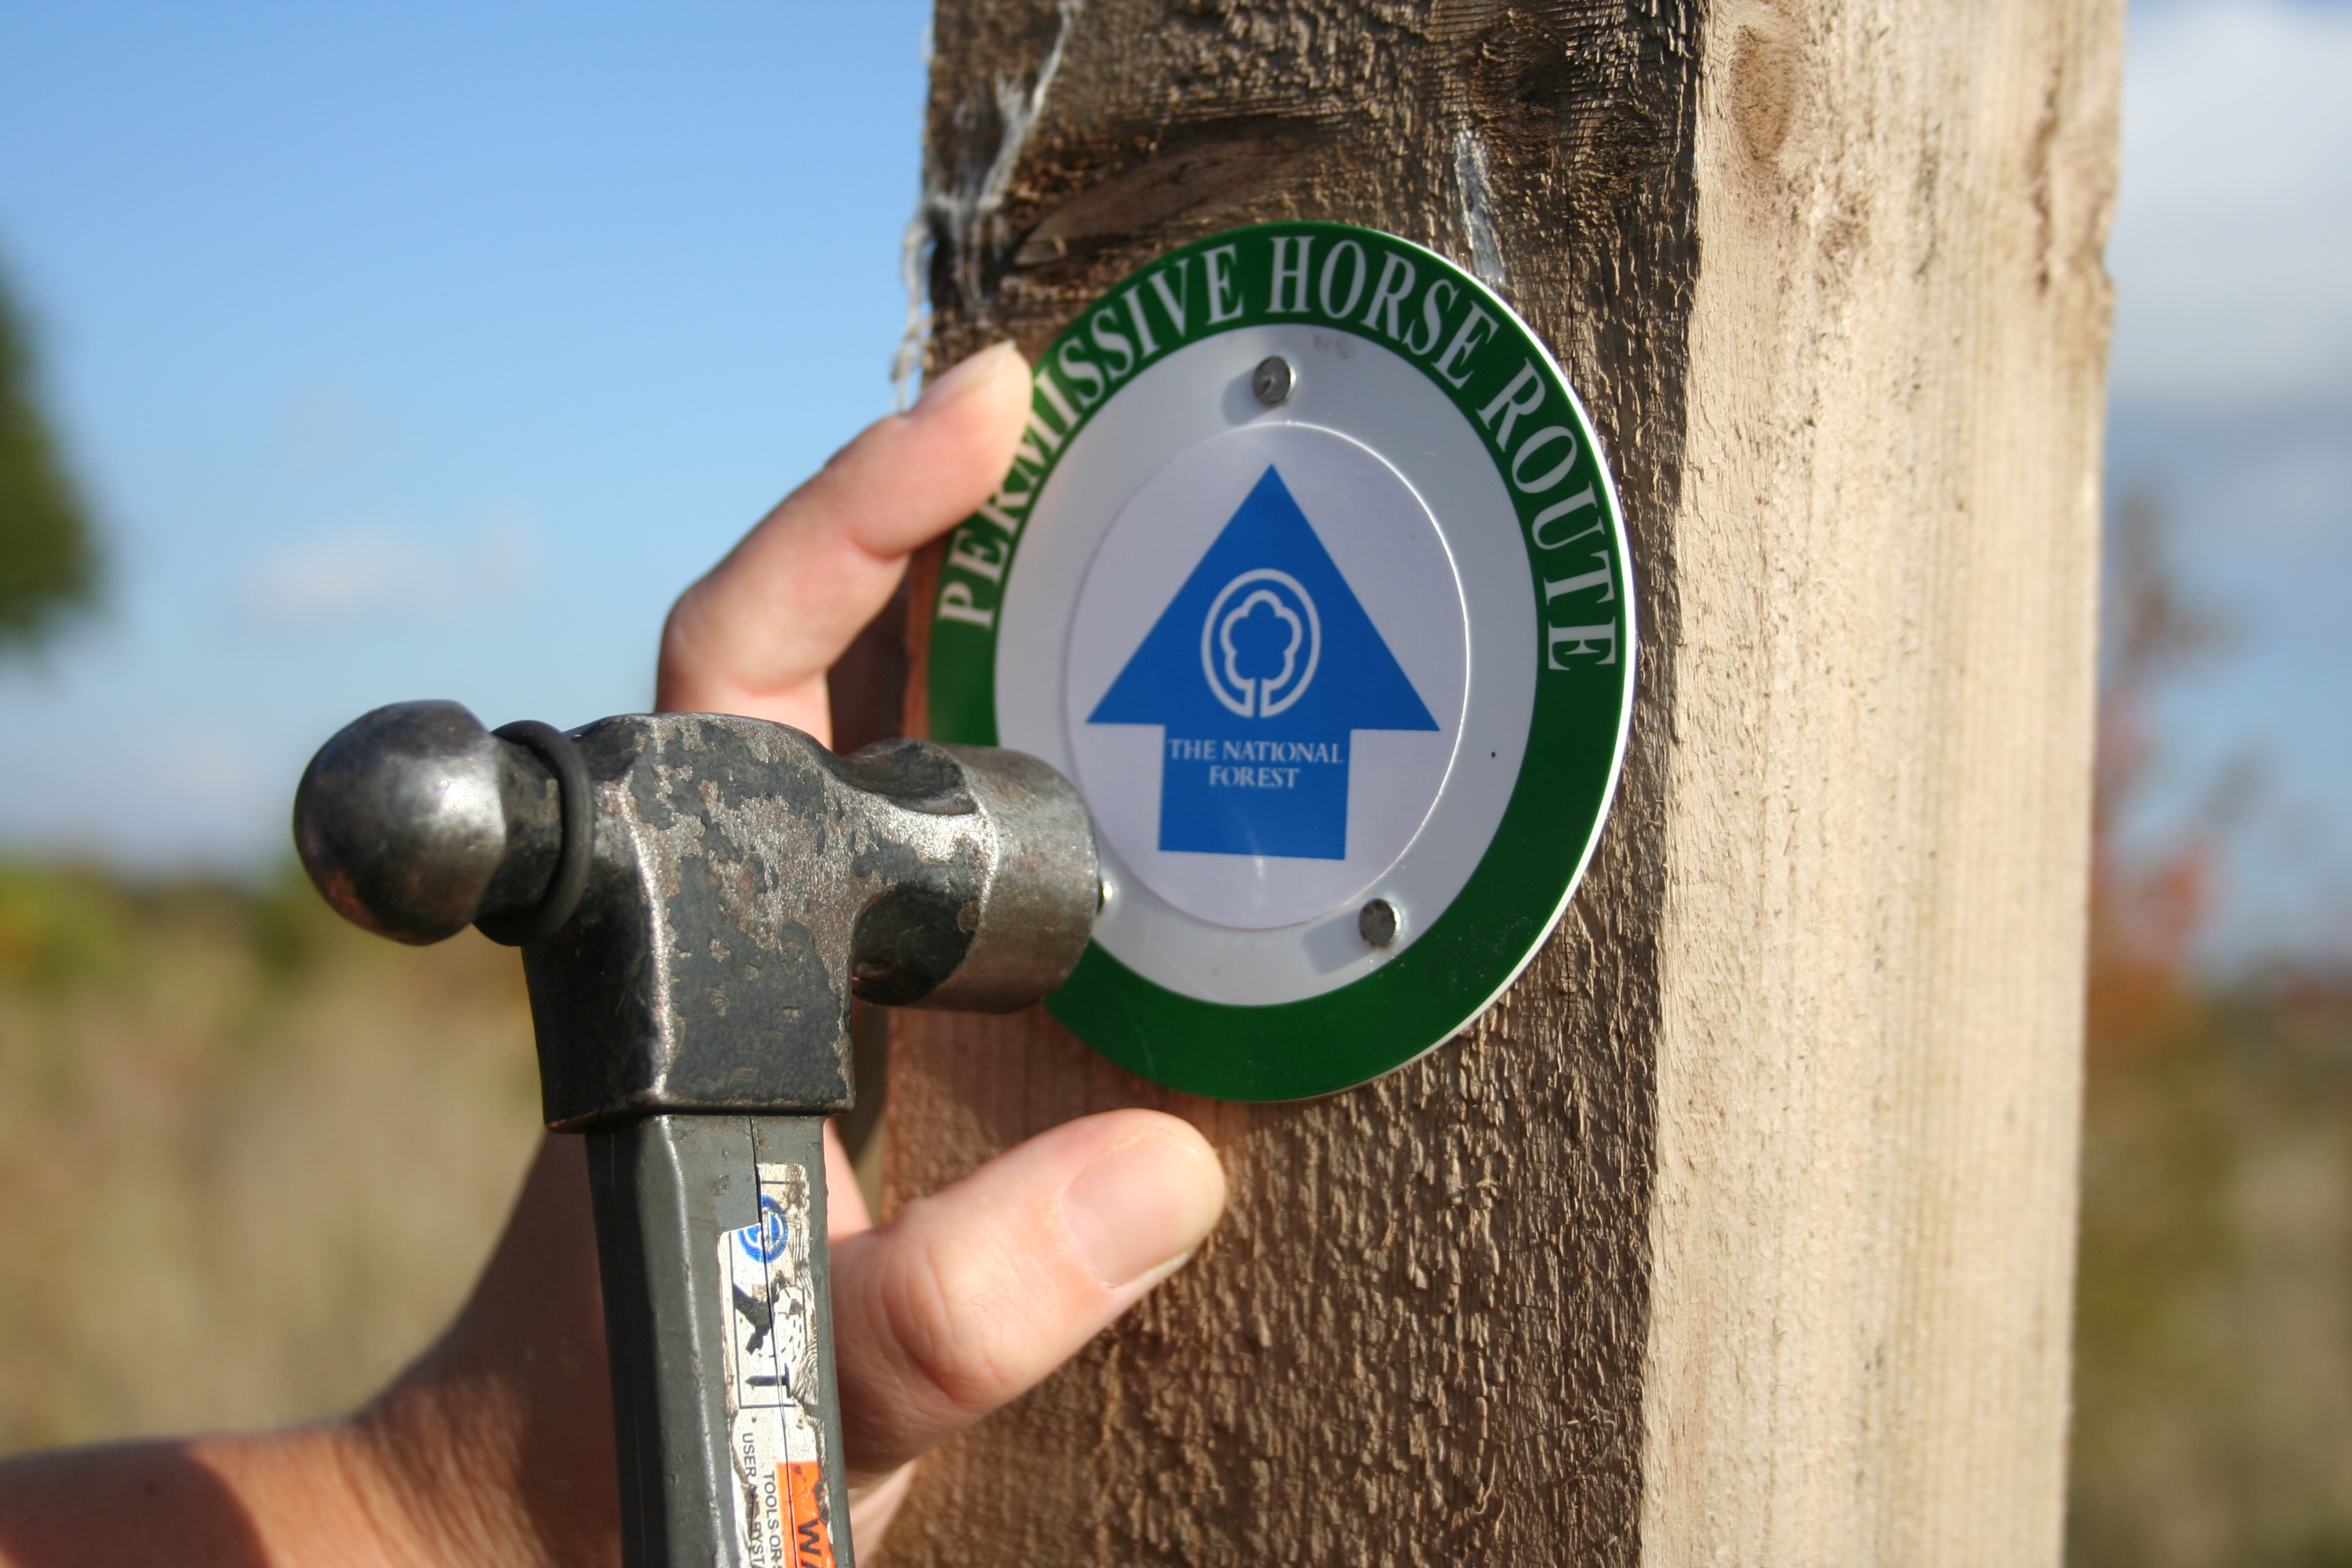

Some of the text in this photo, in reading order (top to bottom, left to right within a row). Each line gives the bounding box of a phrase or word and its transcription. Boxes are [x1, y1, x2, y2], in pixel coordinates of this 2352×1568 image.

[1265, 235, 1500, 390] HORSE
[1475, 356, 1617, 671] ROUTE
[1167, 738, 1344, 764] THE NATIONAL
[1209, 765, 1301, 788] FOREST
[742, 1432, 757, 1477] USER
[763, 1470, 779, 1530] TOOLS
[768, 1534, 783, 1561] OR
